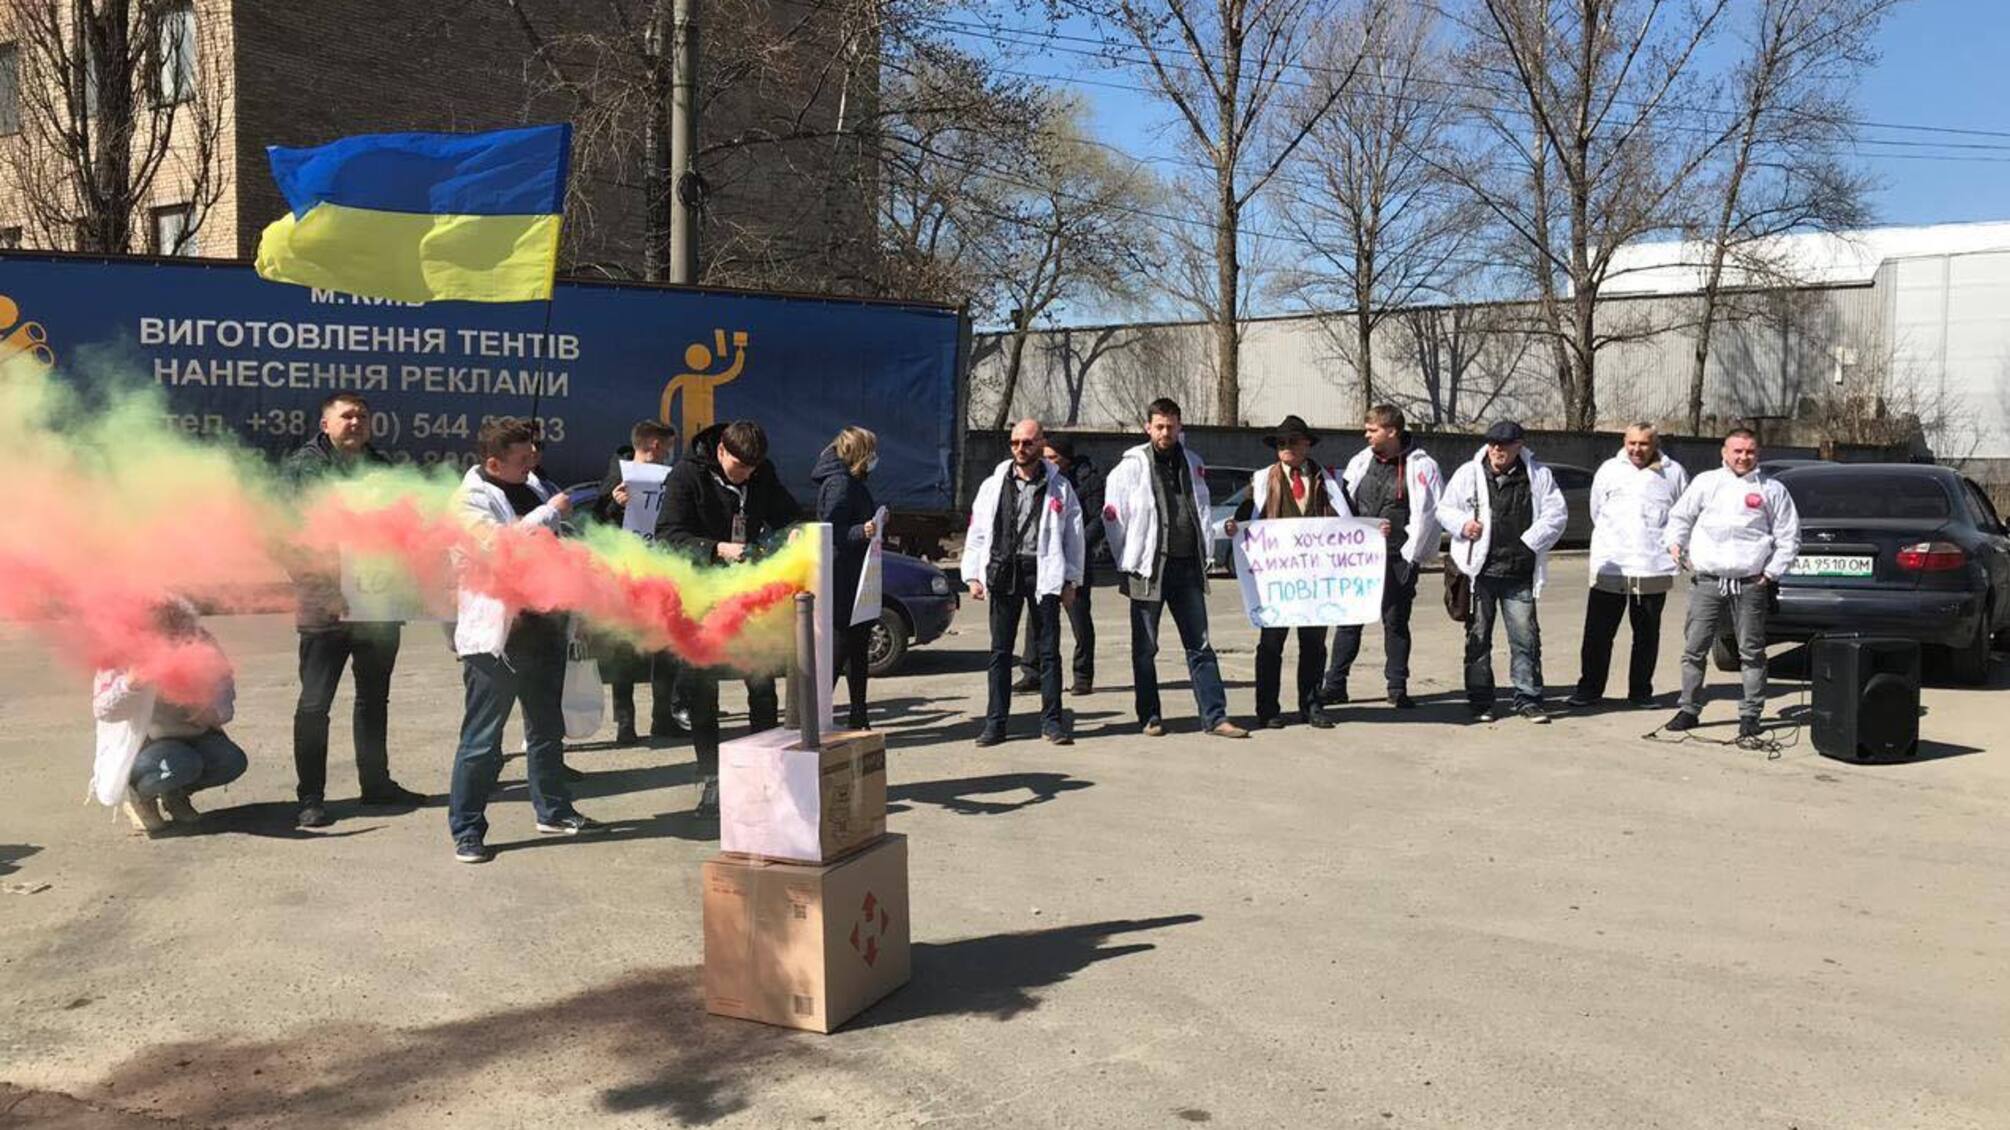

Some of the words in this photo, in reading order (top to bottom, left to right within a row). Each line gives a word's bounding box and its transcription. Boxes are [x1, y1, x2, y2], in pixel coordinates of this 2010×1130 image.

[139, 317, 446, 354] ВИГОТОВЛЕННЯ
[457, 329, 580, 360] ТЕНТІВ
[154, 358, 388, 390] НАНЕСЕННЯ
[401, 365, 568, 397] РЕКЛАМИ
[245, 409, 306, 435] +38
[413, 412, 471, 438] 544
[1244, 526, 1279, 552] Ми
[1815, 558, 1847, 570] 9510
